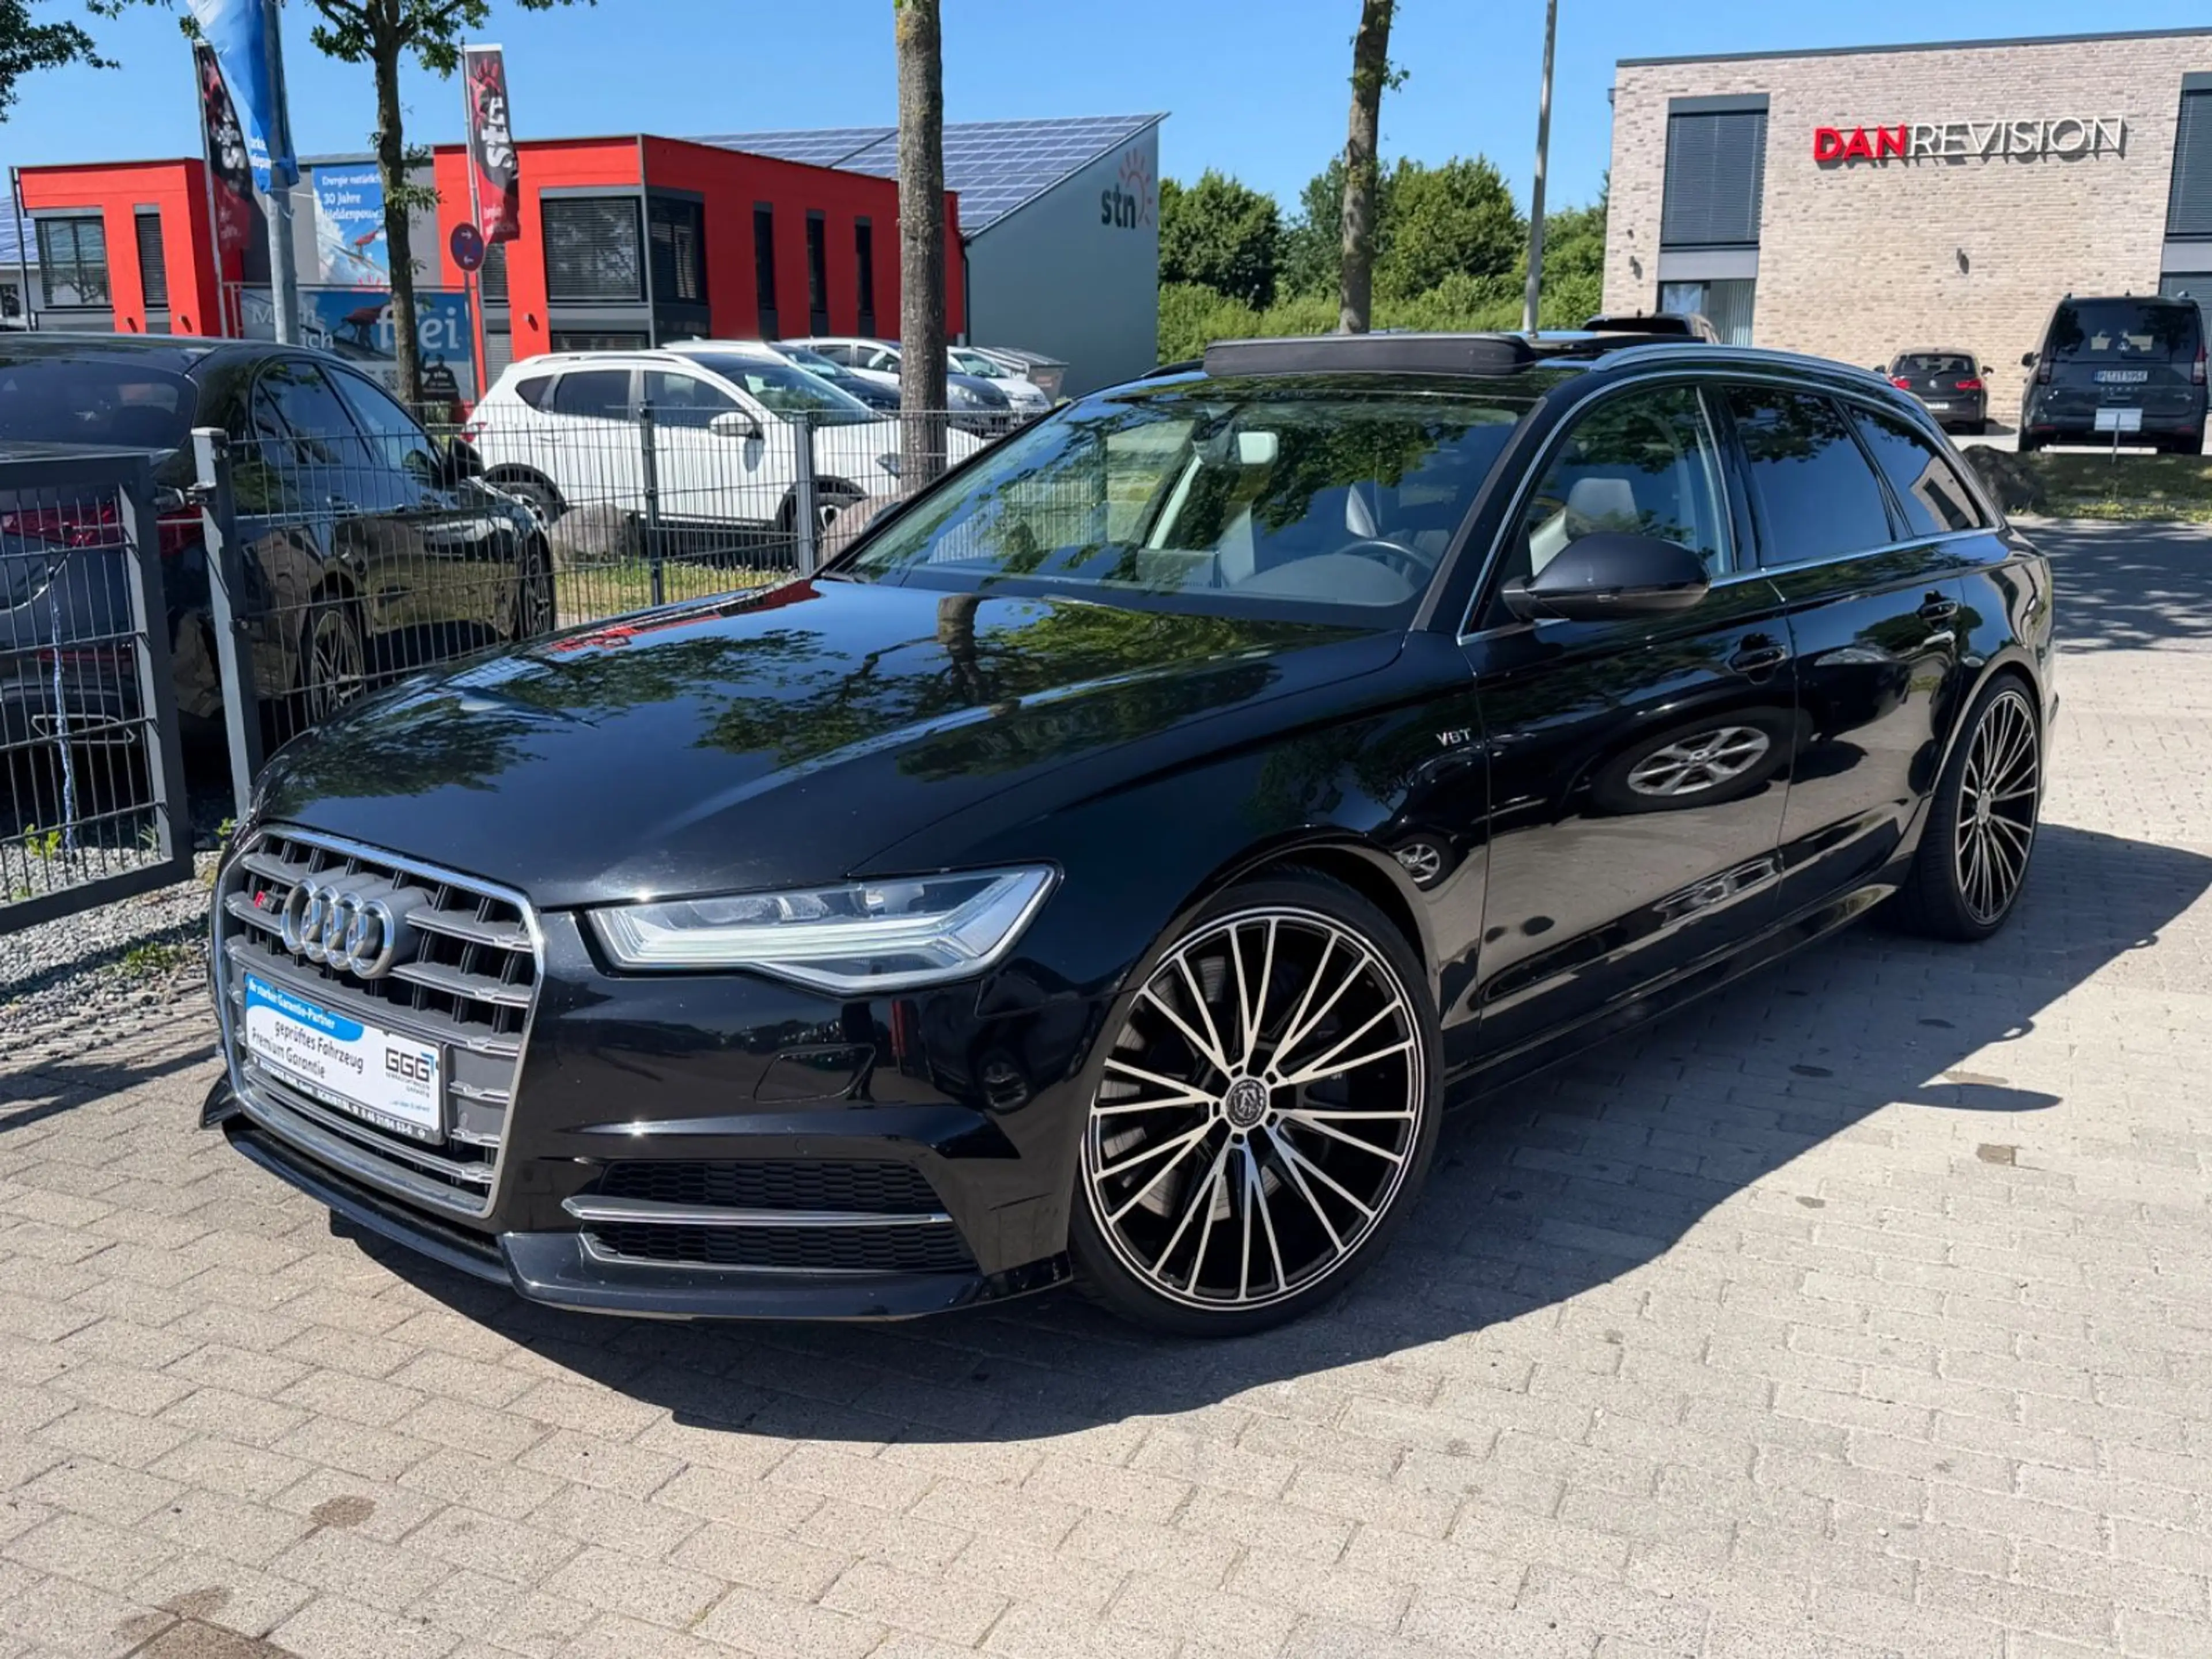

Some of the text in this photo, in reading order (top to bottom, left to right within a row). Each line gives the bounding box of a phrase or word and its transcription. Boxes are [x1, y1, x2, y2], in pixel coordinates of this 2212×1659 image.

[1813, 115, 2124, 161] DANREVISION
[337, 191, 361, 206] Jahre
[1101, 181, 1136, 229] stn
[299, 327, 335, 349] ich
[376, 304, 460, 350] fei
[252, 1026, 285, 1059] Premium
[286, 1046, 326, 1080] Garantie
[274, 1021, 316, 1051] geprüftes
[317, 1036, 363, 1075] Fahrzeug
[385, 1046, 430, 1083] GGG
